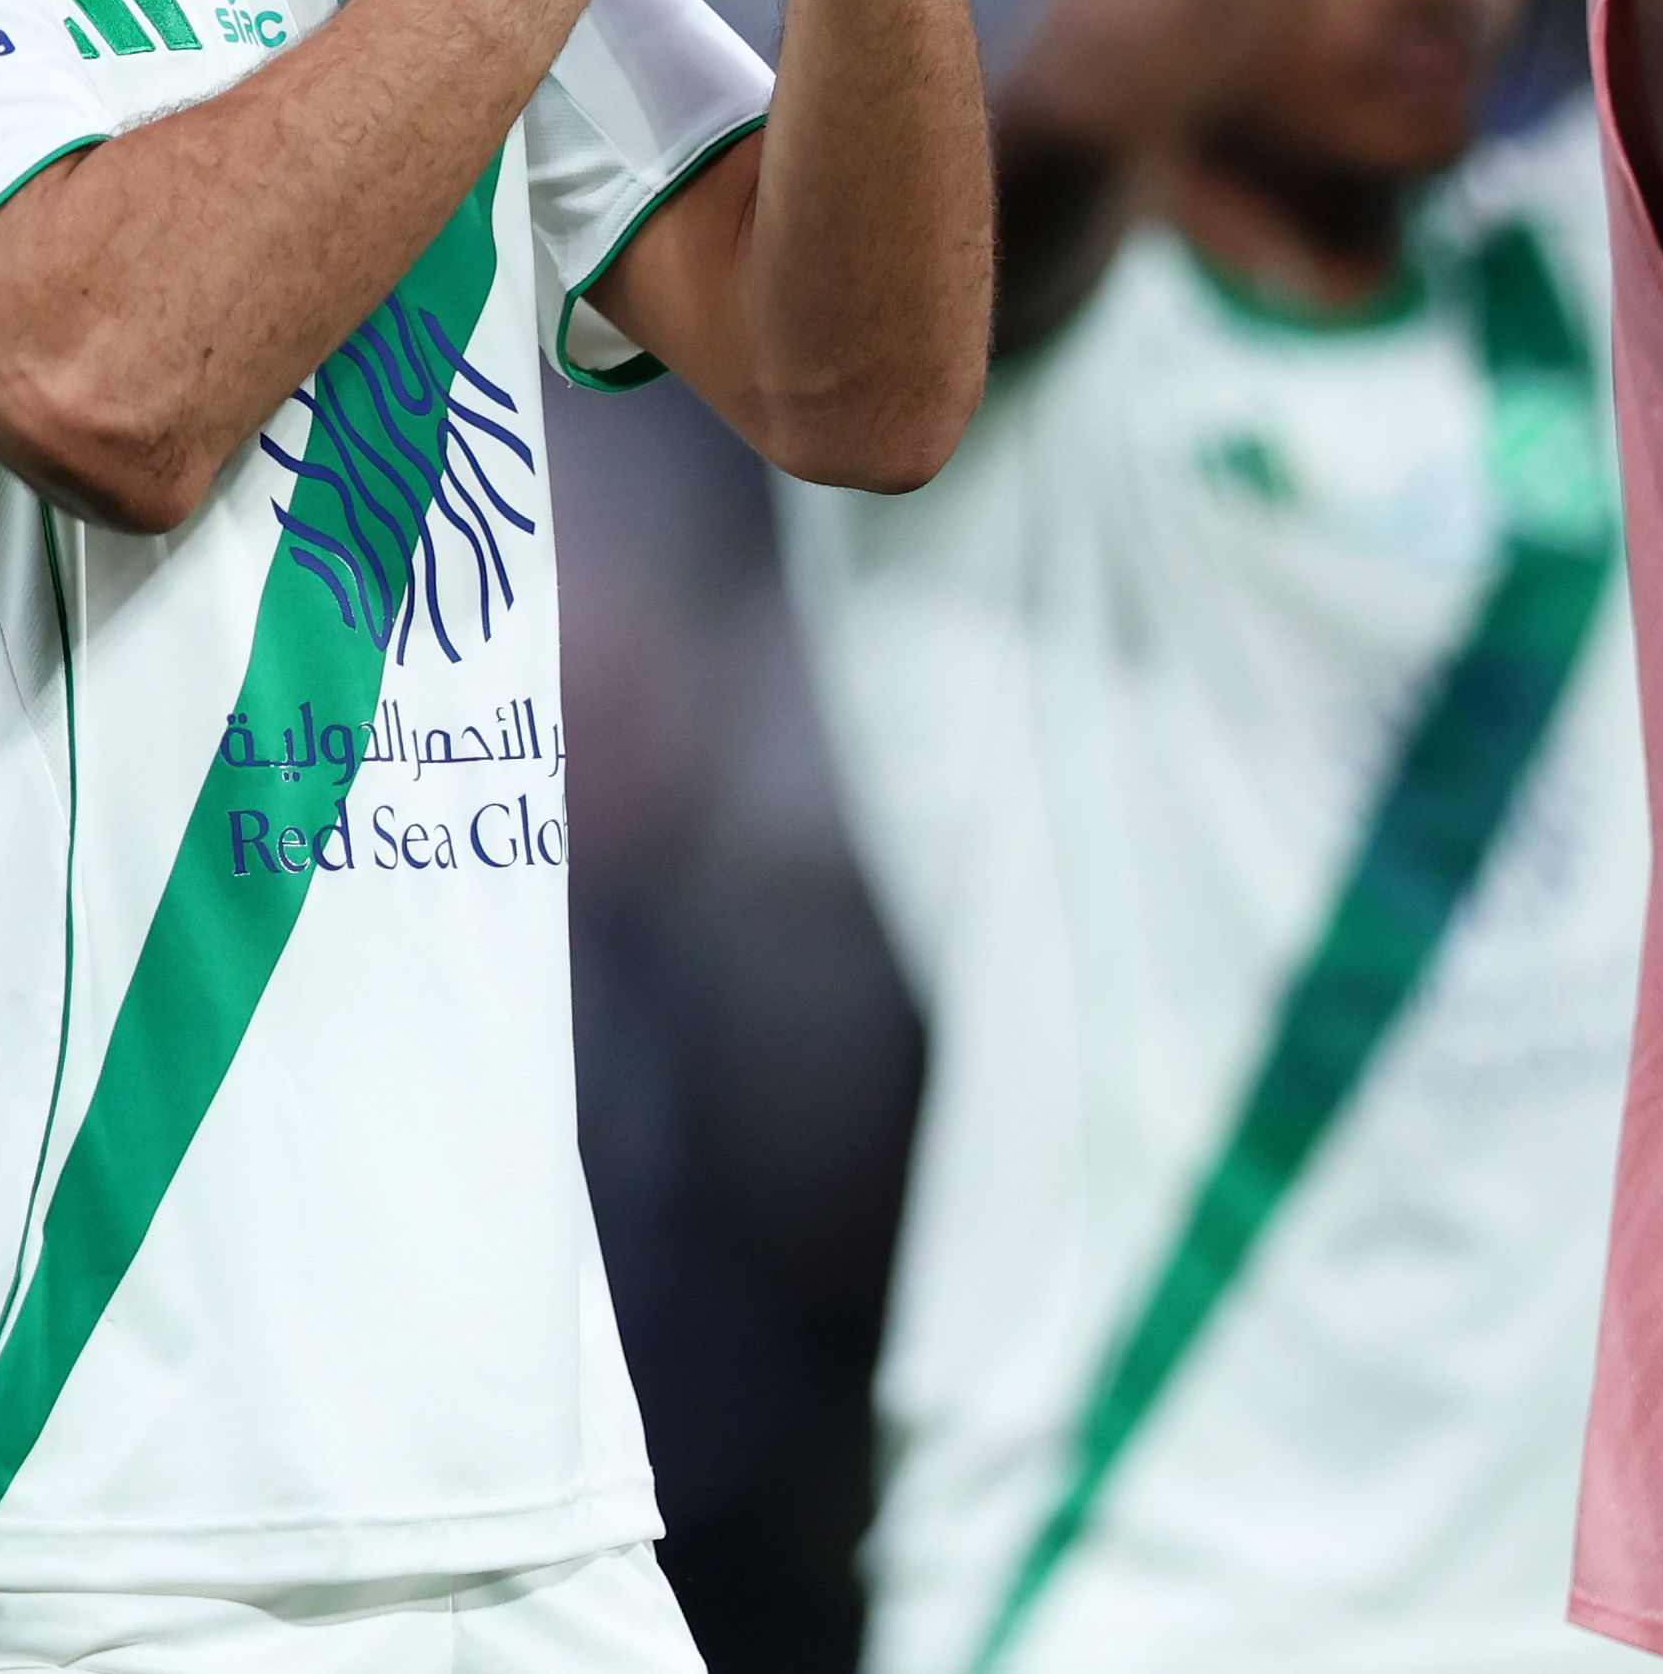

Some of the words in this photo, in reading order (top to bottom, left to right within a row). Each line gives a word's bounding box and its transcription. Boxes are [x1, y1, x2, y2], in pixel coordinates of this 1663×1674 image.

[219, 698, 409, 787] الدولية
[412, 696, 544, 782] الأحمر
[226, 795, 357, 877] Red
[371, 804, 459, 871] Sea
